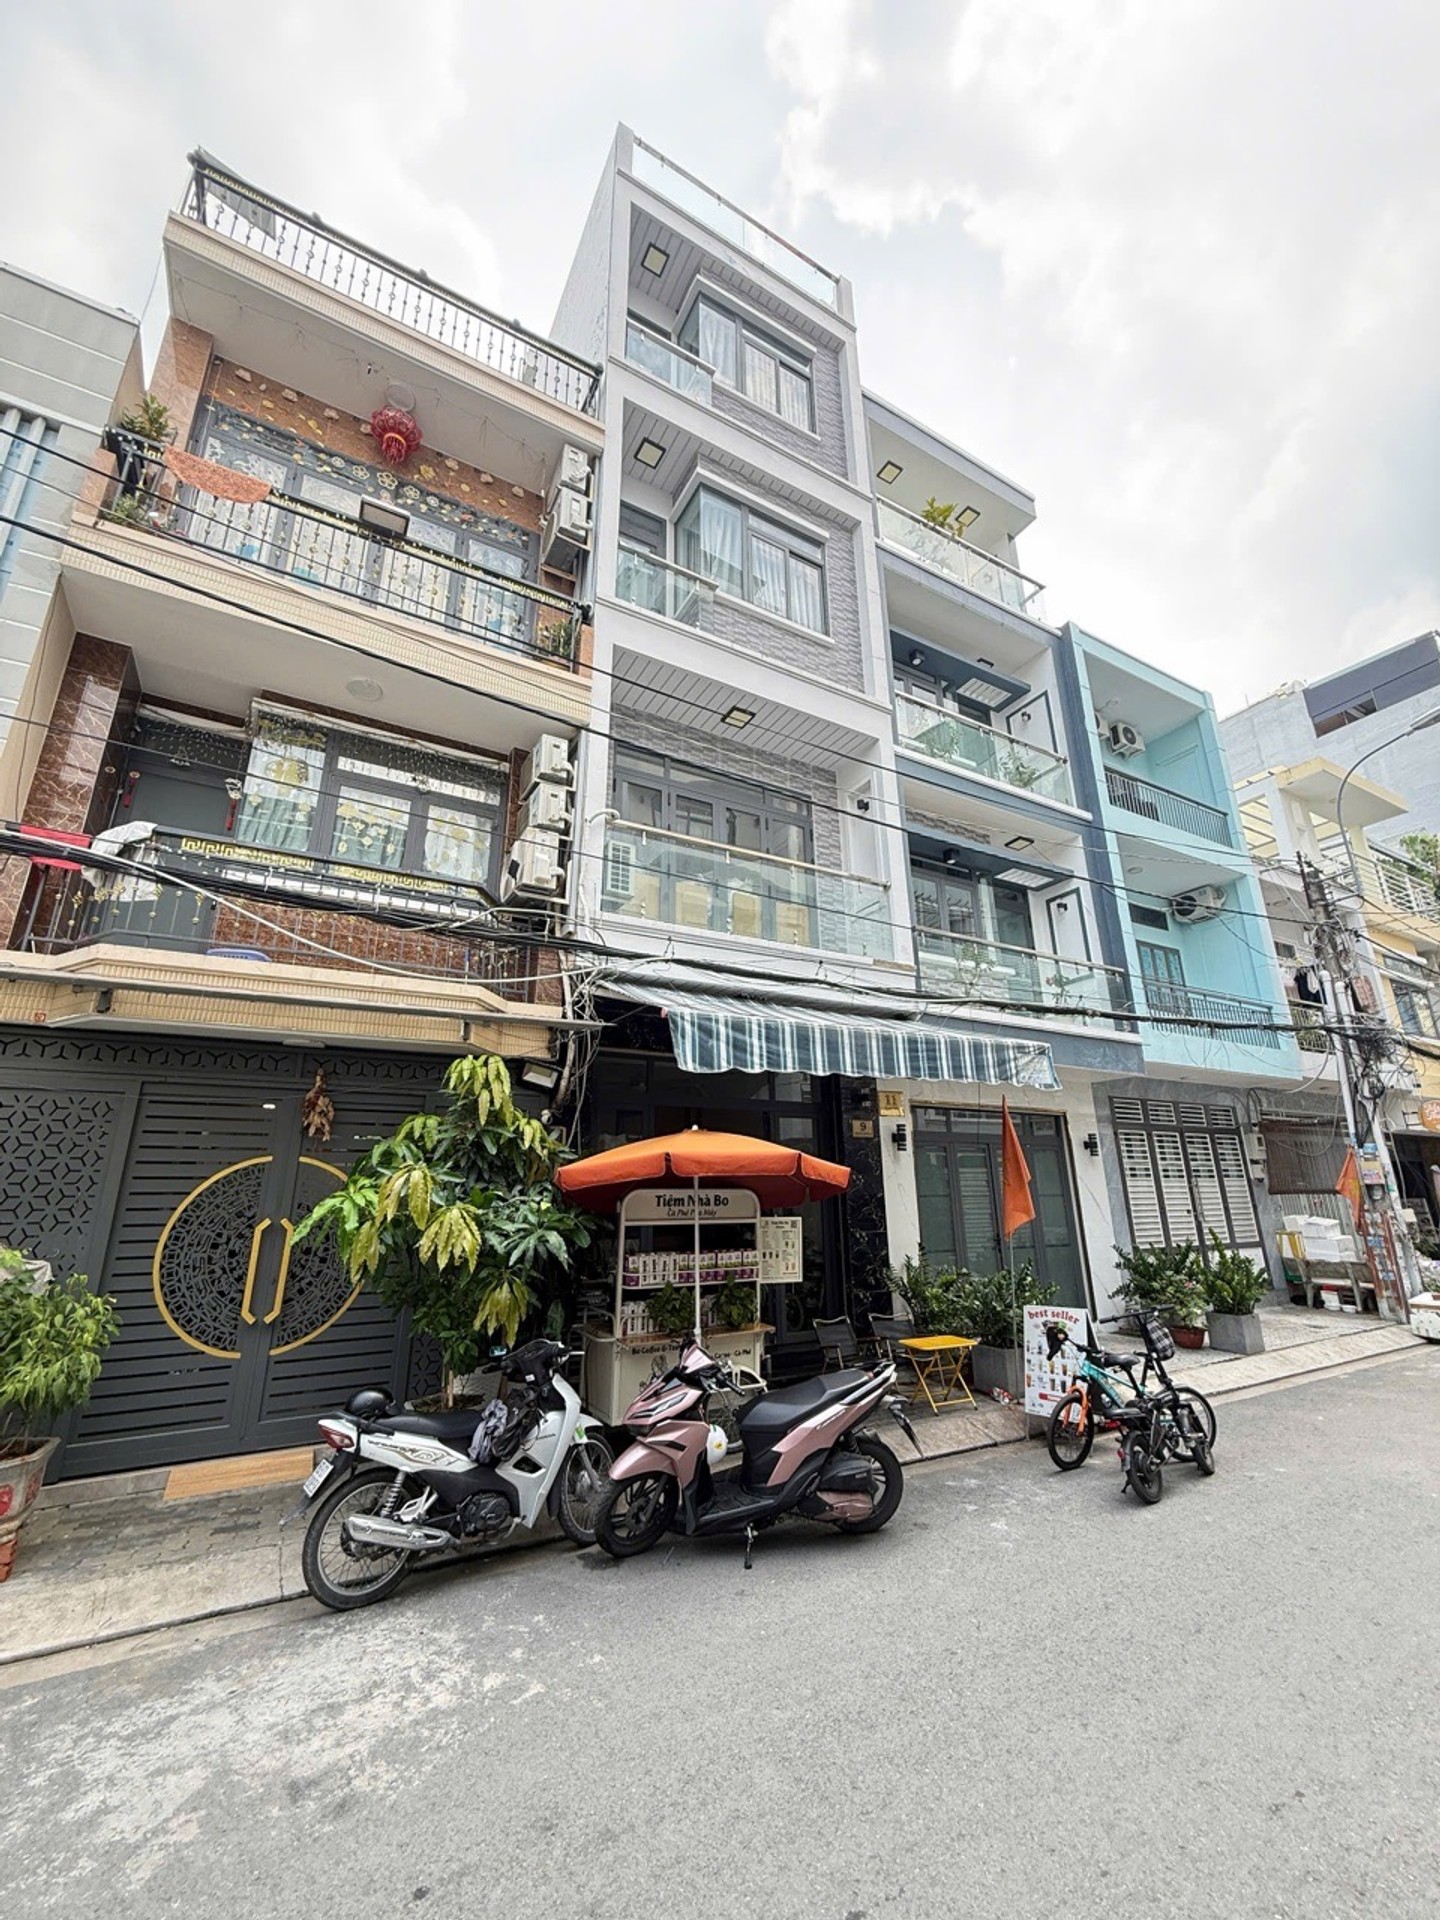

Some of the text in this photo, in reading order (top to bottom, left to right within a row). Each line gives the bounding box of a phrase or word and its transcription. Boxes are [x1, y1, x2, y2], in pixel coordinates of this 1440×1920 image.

[885, 1094, 897, 1106] 11
[860, 1122, 867, 1131] 9
[714, 1194, 729, 1206] Bo
[1028, 1310, 1080, 1324] best seller
